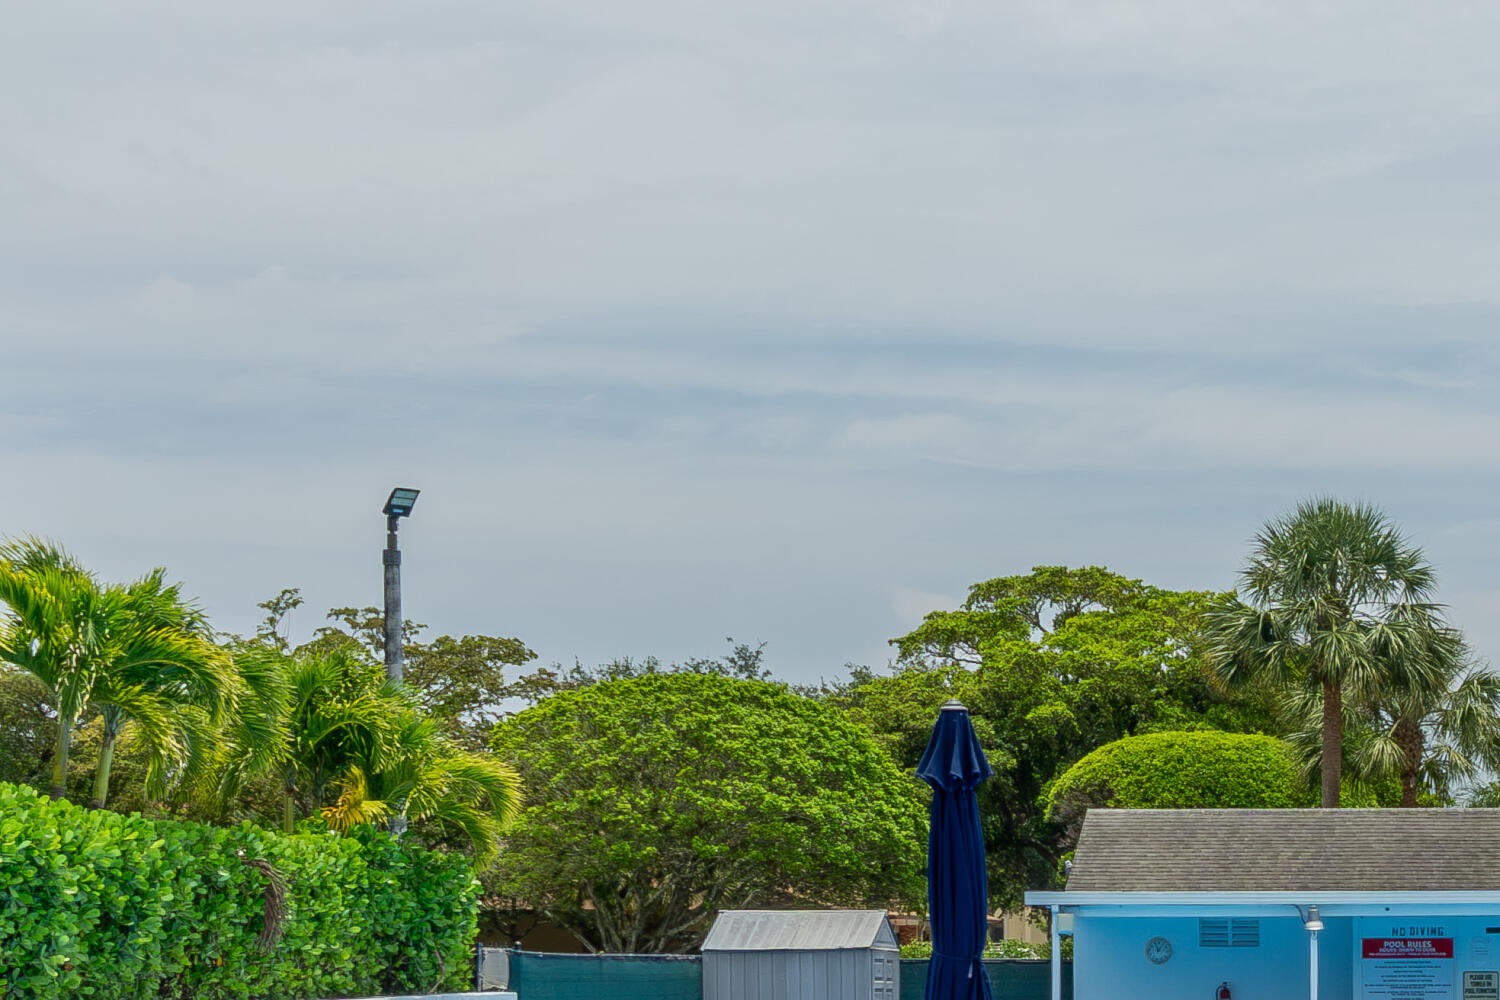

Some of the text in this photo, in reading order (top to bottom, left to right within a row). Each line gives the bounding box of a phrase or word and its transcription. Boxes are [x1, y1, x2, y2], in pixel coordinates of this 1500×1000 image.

[1392, 926, 1444, 936] NO DIVING
[1407, 940, 1432, 948] RULES
